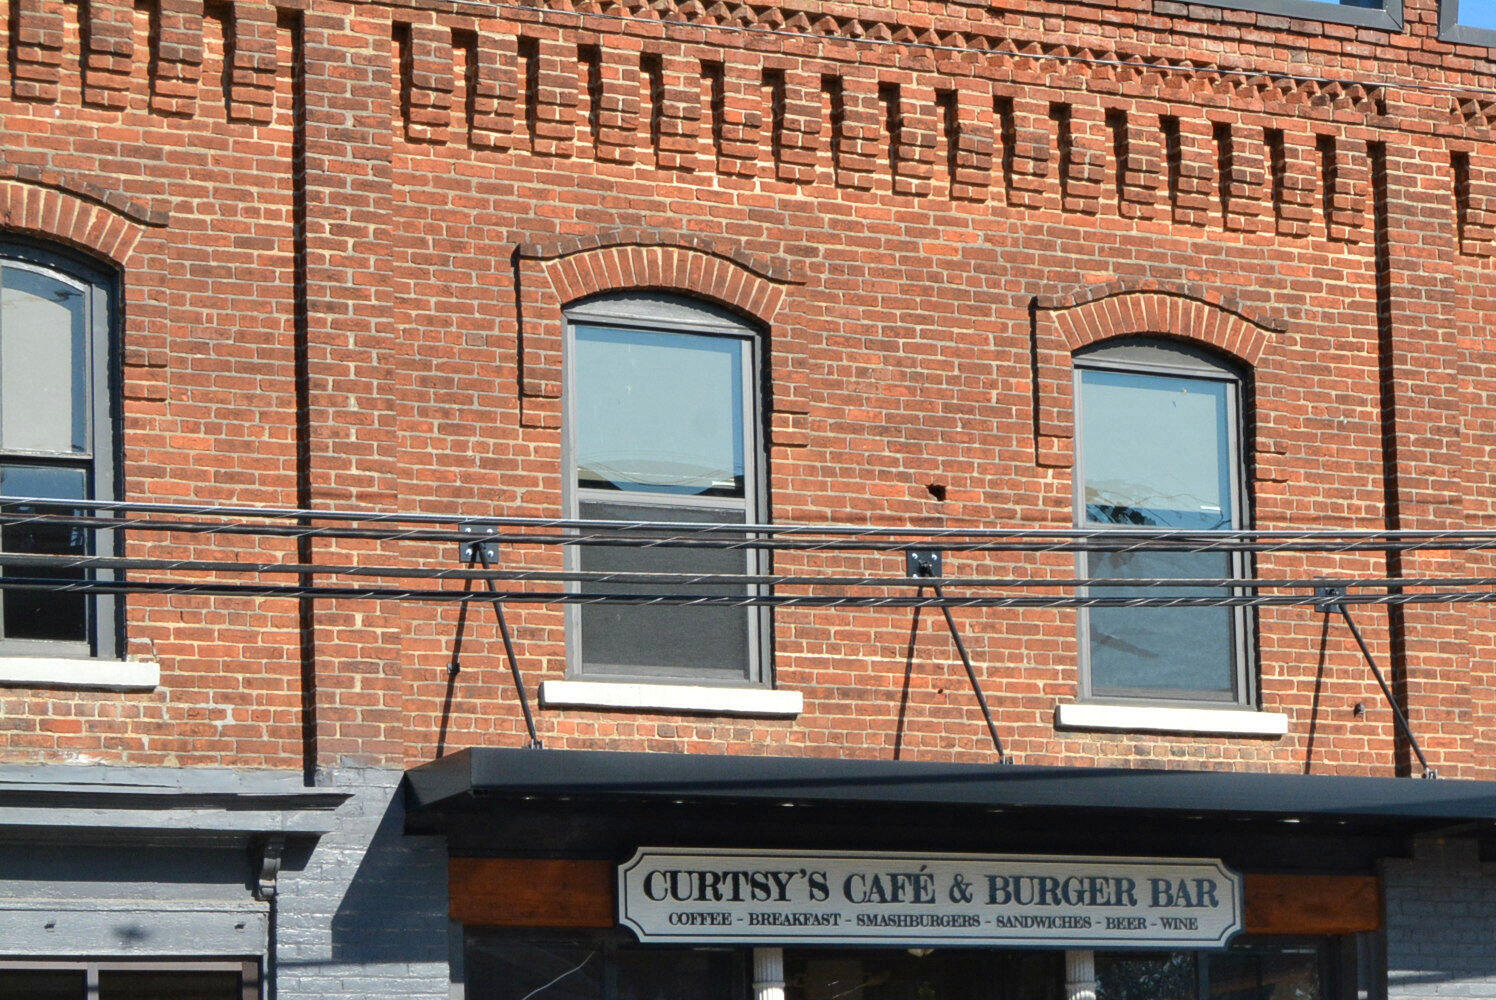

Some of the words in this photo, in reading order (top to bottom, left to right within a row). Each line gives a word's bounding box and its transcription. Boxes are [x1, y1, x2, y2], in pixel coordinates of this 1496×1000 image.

[643, 868, 830, 902] CURTSY'S
[843, 865, 936, 904] CAFÉ
[949, 873, 973, 904] &
[984, 874, 1138, 907] BURGER
[1148, 878, 1220, 908] BAR
[668, 912, 732, 926] COFFEE
[750, 912, 841, 926] BREAKFAST
[856, 913, 980, 928] SMASHBURGERS
[996, 915, 1092, 929] SANDWICHES
[1105, 917, 1147, 930] BEER
[1159, 917, 1198, 931] WINE
